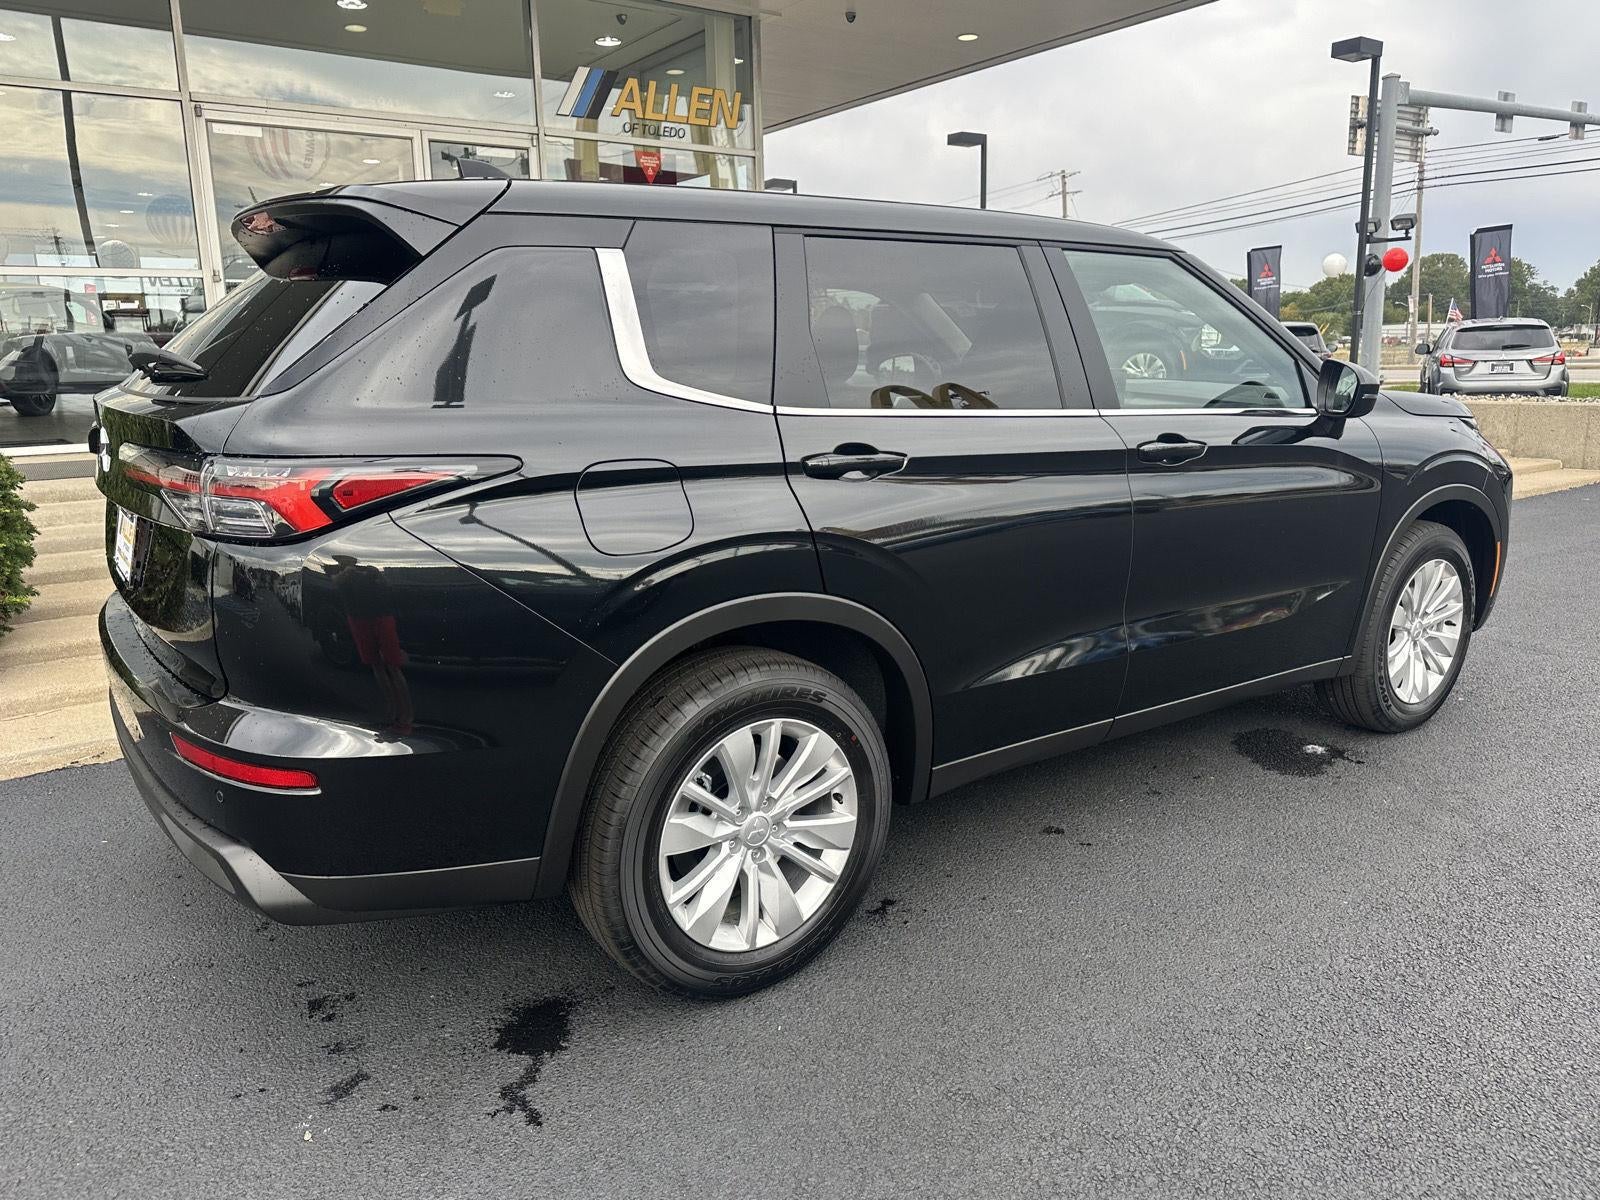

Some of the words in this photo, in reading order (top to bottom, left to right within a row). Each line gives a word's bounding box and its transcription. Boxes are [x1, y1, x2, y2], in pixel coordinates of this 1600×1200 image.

[611, 76, 742, 129] ALLEN
[623, 121, 639, 135] OF
[641, 122, 687, 139] TOLEDO
